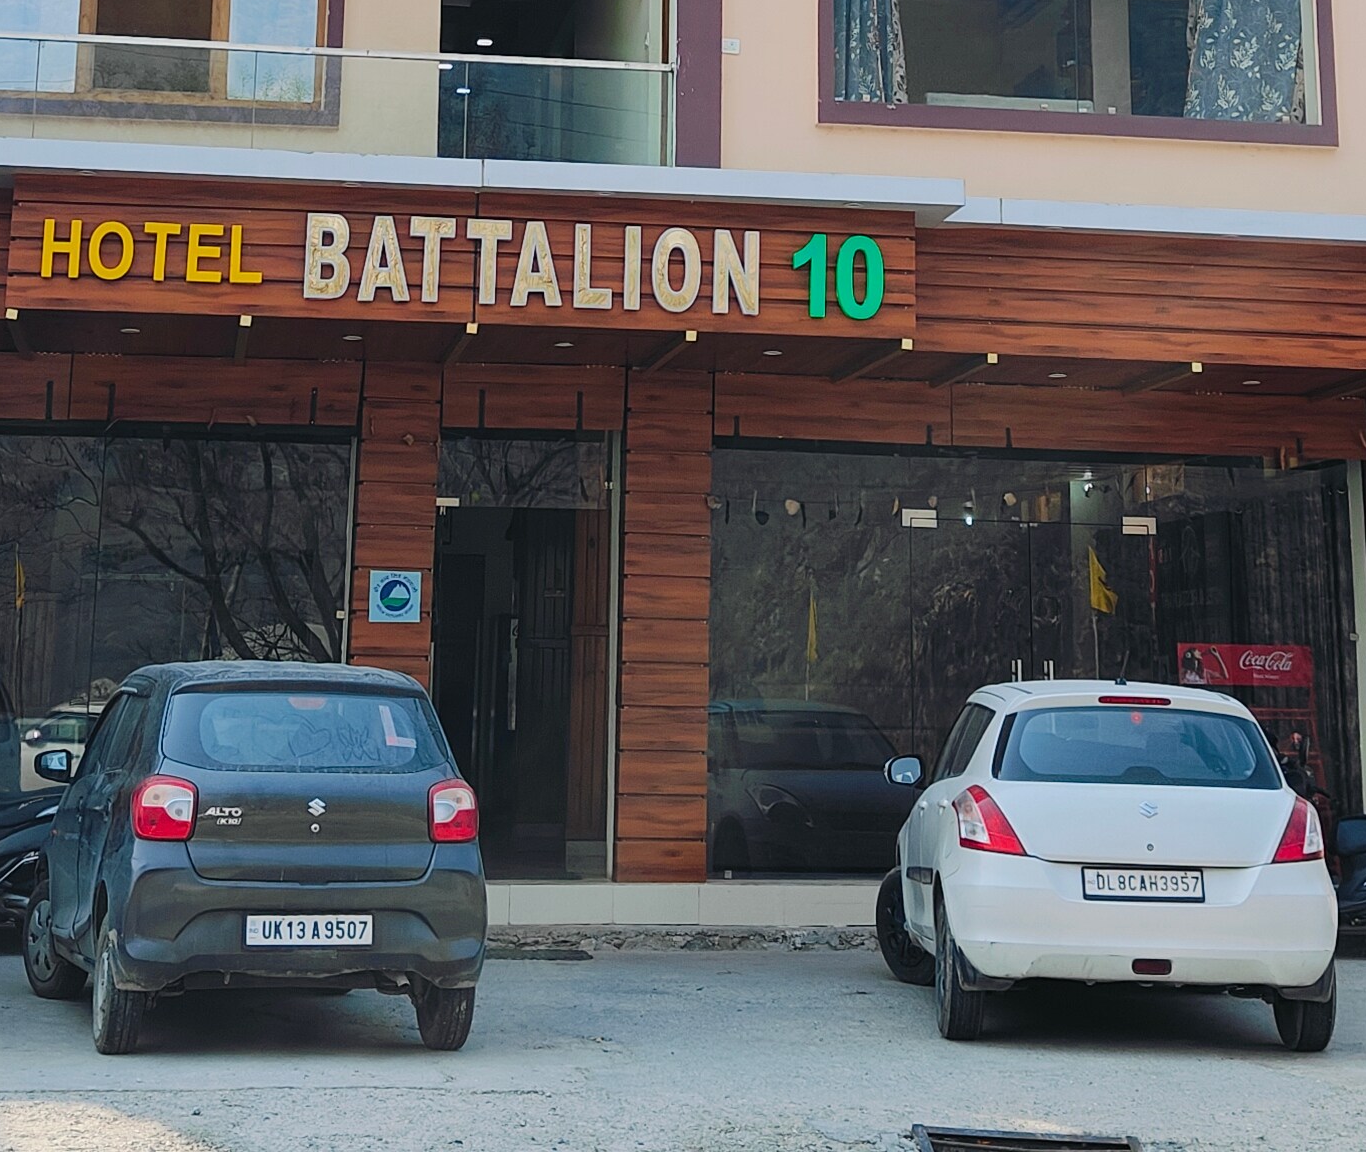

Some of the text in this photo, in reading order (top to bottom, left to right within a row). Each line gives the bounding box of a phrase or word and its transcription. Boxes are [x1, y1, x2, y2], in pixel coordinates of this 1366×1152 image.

[39, 211, 887, 321] HOTEL BATTALION 10
[205, 806, 242, 817] ALTO
[1096, 873, 1200, 892] DL8CAH3957
